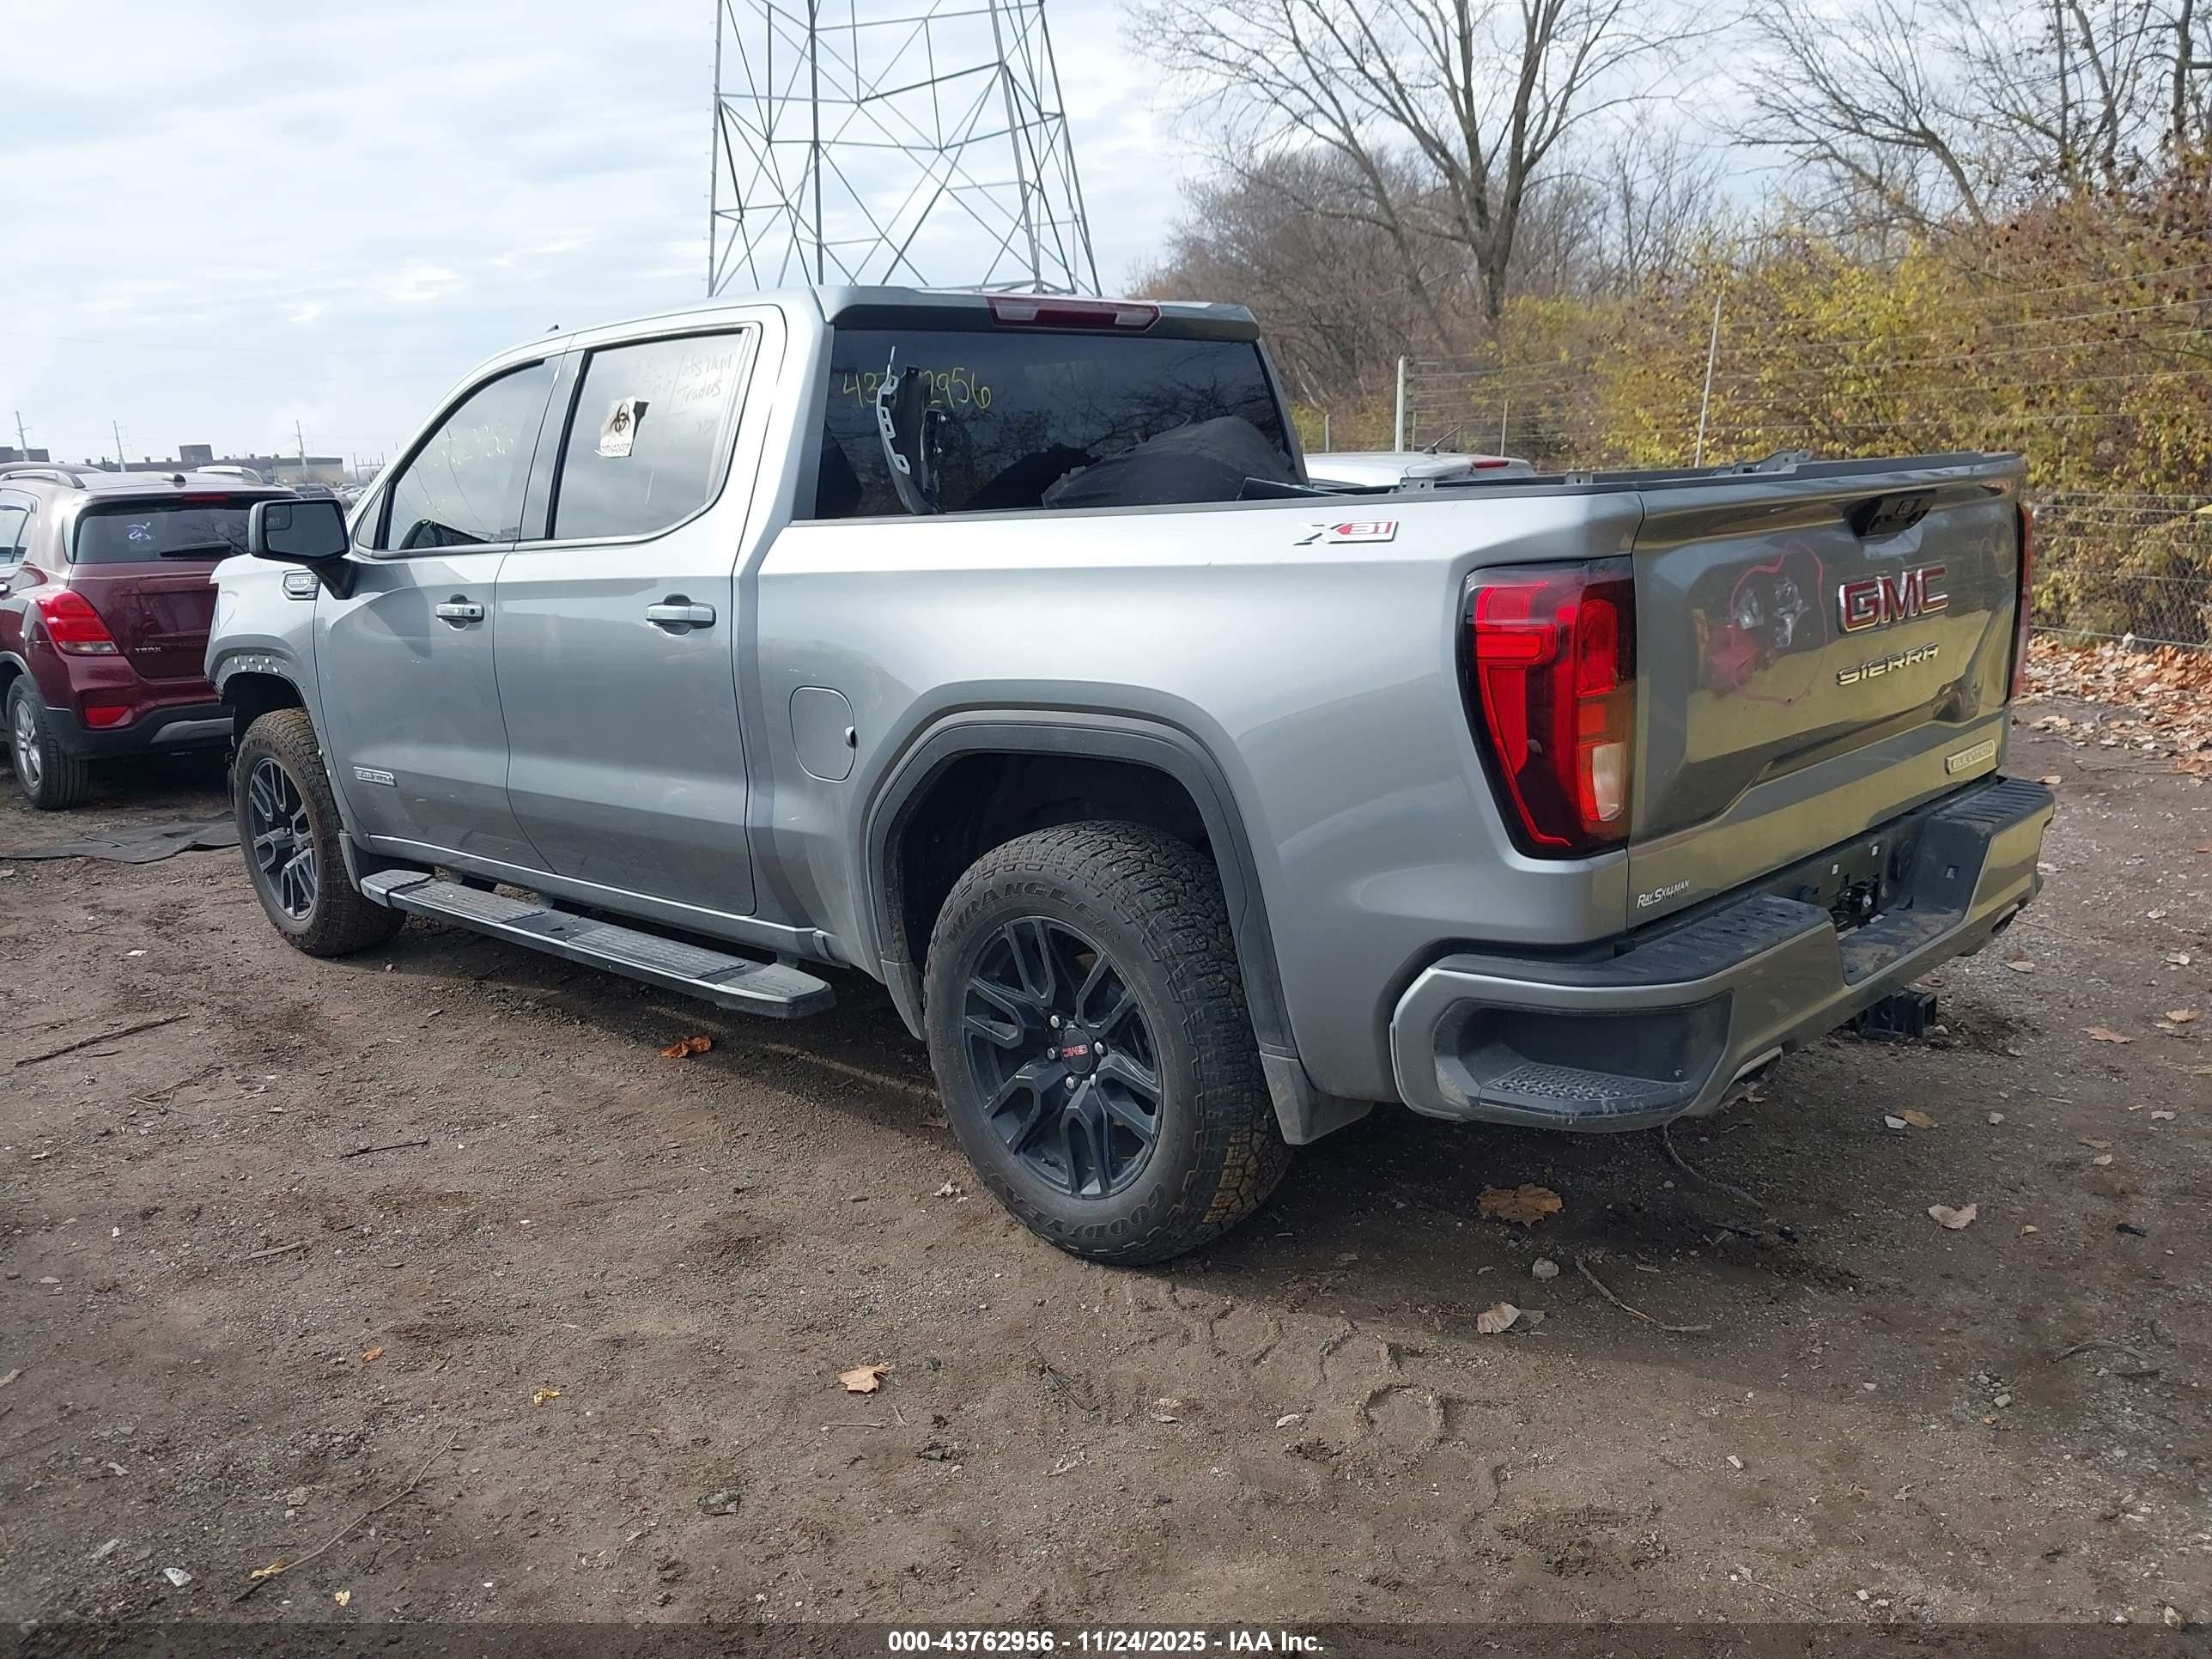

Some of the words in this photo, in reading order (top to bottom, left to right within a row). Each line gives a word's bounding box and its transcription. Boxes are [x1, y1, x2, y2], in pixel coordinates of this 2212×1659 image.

[842, 367, 992, 410] 432956
[1838, 565, 1949, 632] GMC
[1836, 642, 1940, 686] SIERRA
[1636, 893, 1655, 909] RAY
[1654, 878, 1690, 903] SKILLMAN
